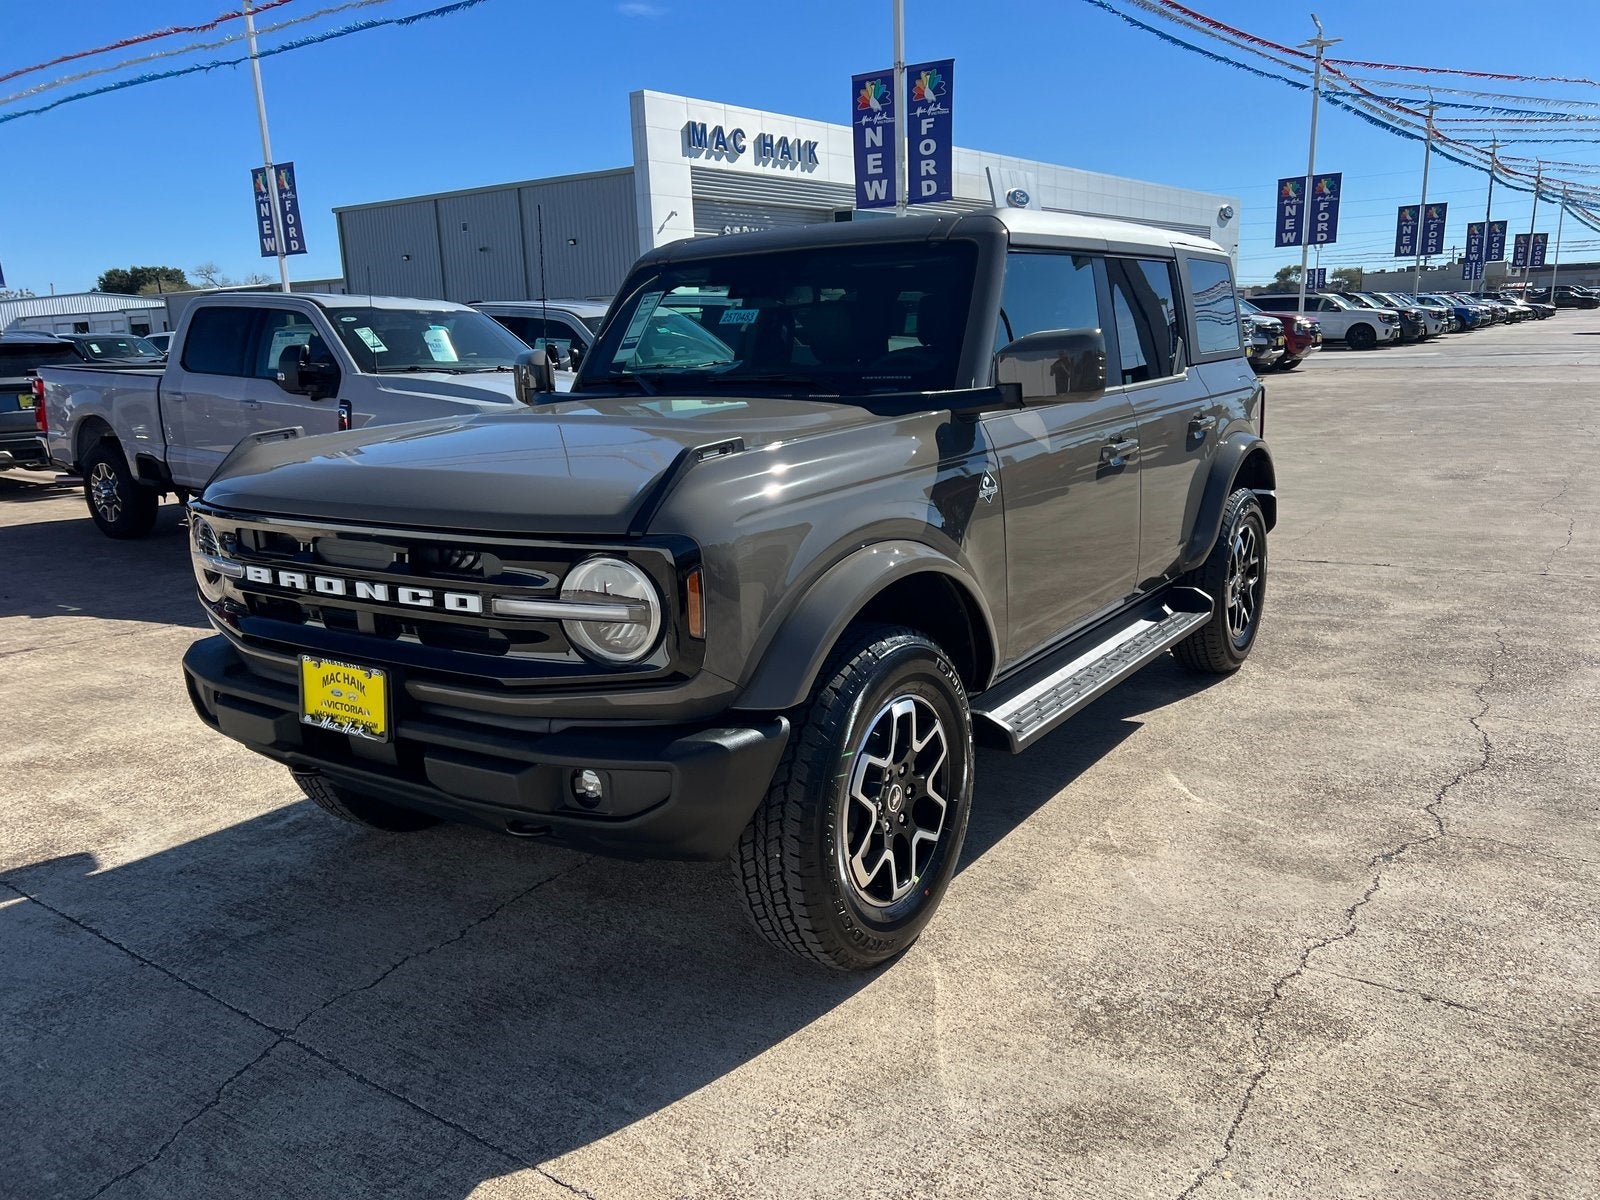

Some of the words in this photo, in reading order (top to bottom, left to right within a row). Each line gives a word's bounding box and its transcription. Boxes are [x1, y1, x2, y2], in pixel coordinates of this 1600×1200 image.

[688, 121, 747, 154] MAC
[760, 133, 820, 165] HAIK
[919, 117, 938, 197] FORD
[863, 126, 888, 201] NEW
[260, 202, 275, 252] NEW
[285, 200, 299, 251] FORD
[1281, 205, 1297, 244] NEW
[1316, 202, 1330, 242] FORD
[1427, 223, 1438, 253] FORD
[1400, 226, 1412, 254] NEW
[1469, 238, 1479, 261] NEW
[1491, 236, 1500, 260] FORD
[720, 312, 755, 323] 25T0483
[246, 565, 483, 613] BRONCO
[322, 672, 341, 688] MAC
[342, 672, 366, 697] HAIK
[326, 699, 364, 716] VICTORIA
[320, 716, 341, 730] Mac
[341, 722, 365, 736] Haik
